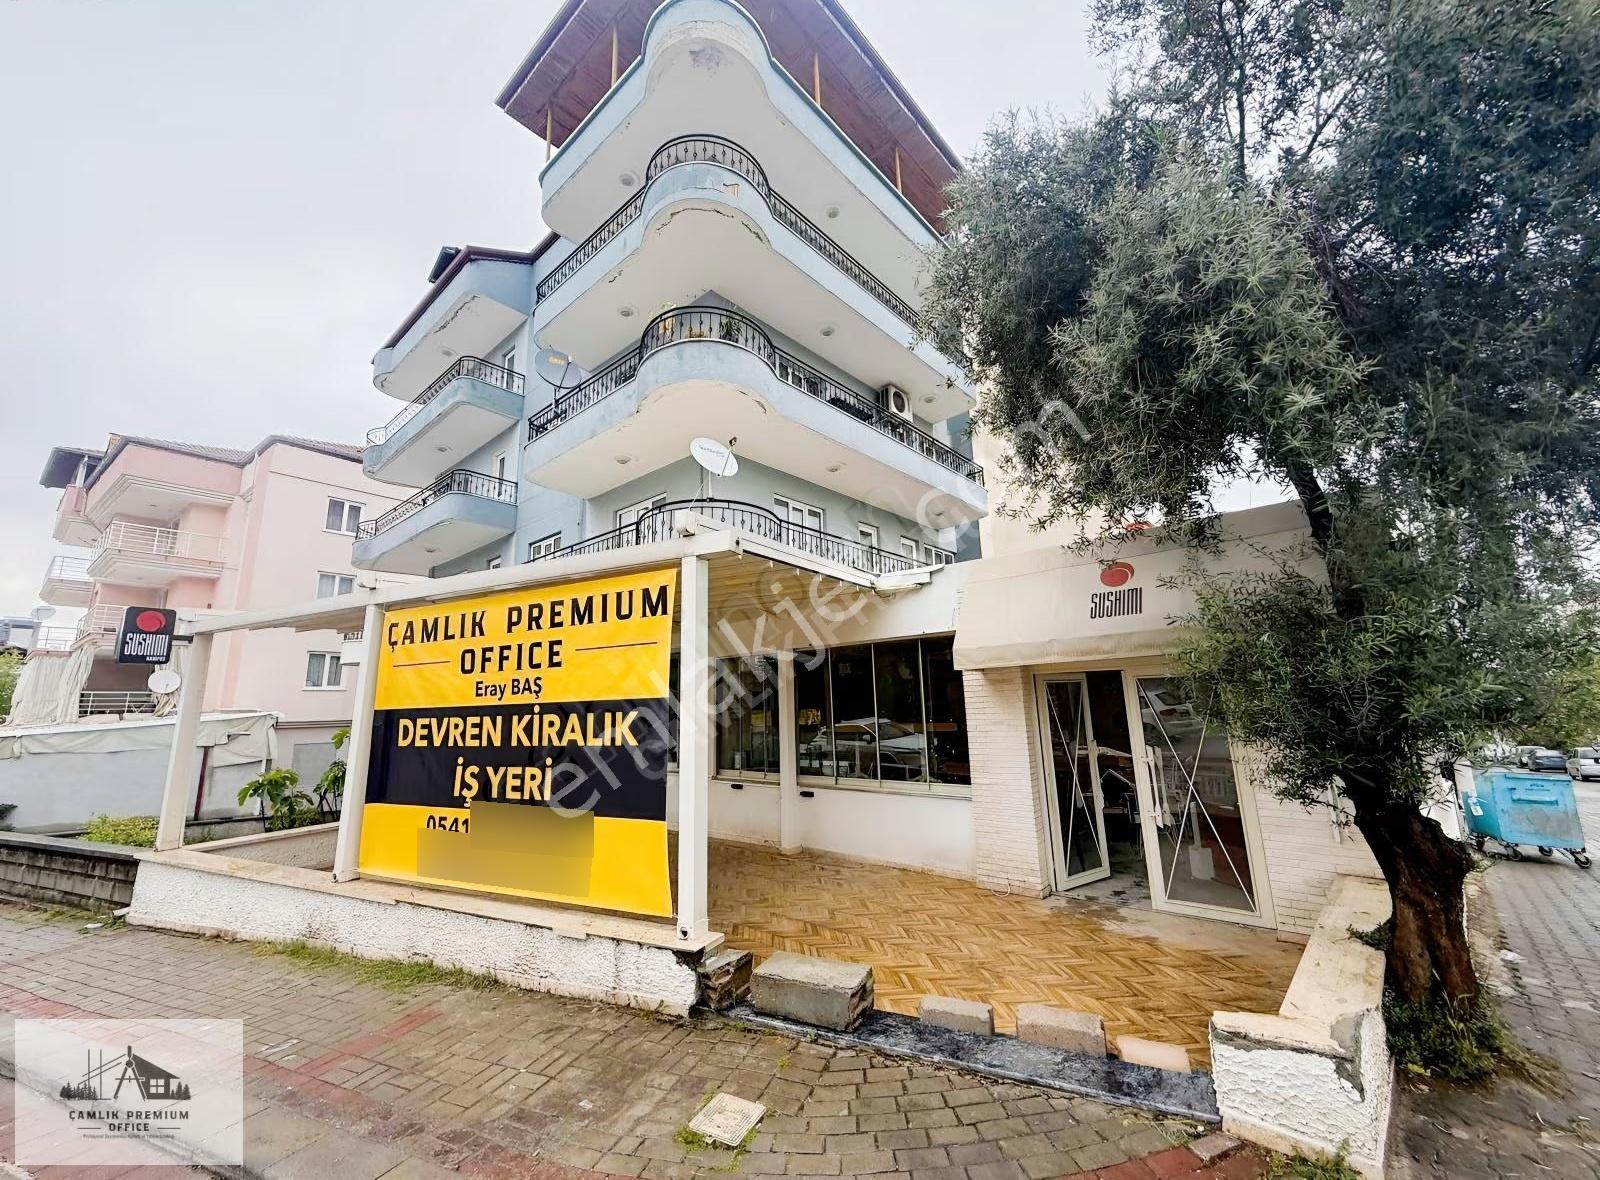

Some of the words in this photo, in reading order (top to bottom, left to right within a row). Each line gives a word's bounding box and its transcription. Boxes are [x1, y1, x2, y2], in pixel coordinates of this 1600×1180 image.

[387, 610, 487, 653] ÇAMLIK
[506, 584, 671, 634] PREMIUM
[1090, 586, 1143, 620] SUSHIMI
[124, 633, 169, 656] SUSHIMI
[460, 639, 564, 675] OFFICE
[475, 680, 507, 701] Eray
[511, 676, 543, 700] BAŞ
[397, 714, 503, 748] DEVREN
[511, 704, 639, 748] KİRALIK
[453, 756, 480, 808] İŞ
[486, 756, 553, 801] YERİ
